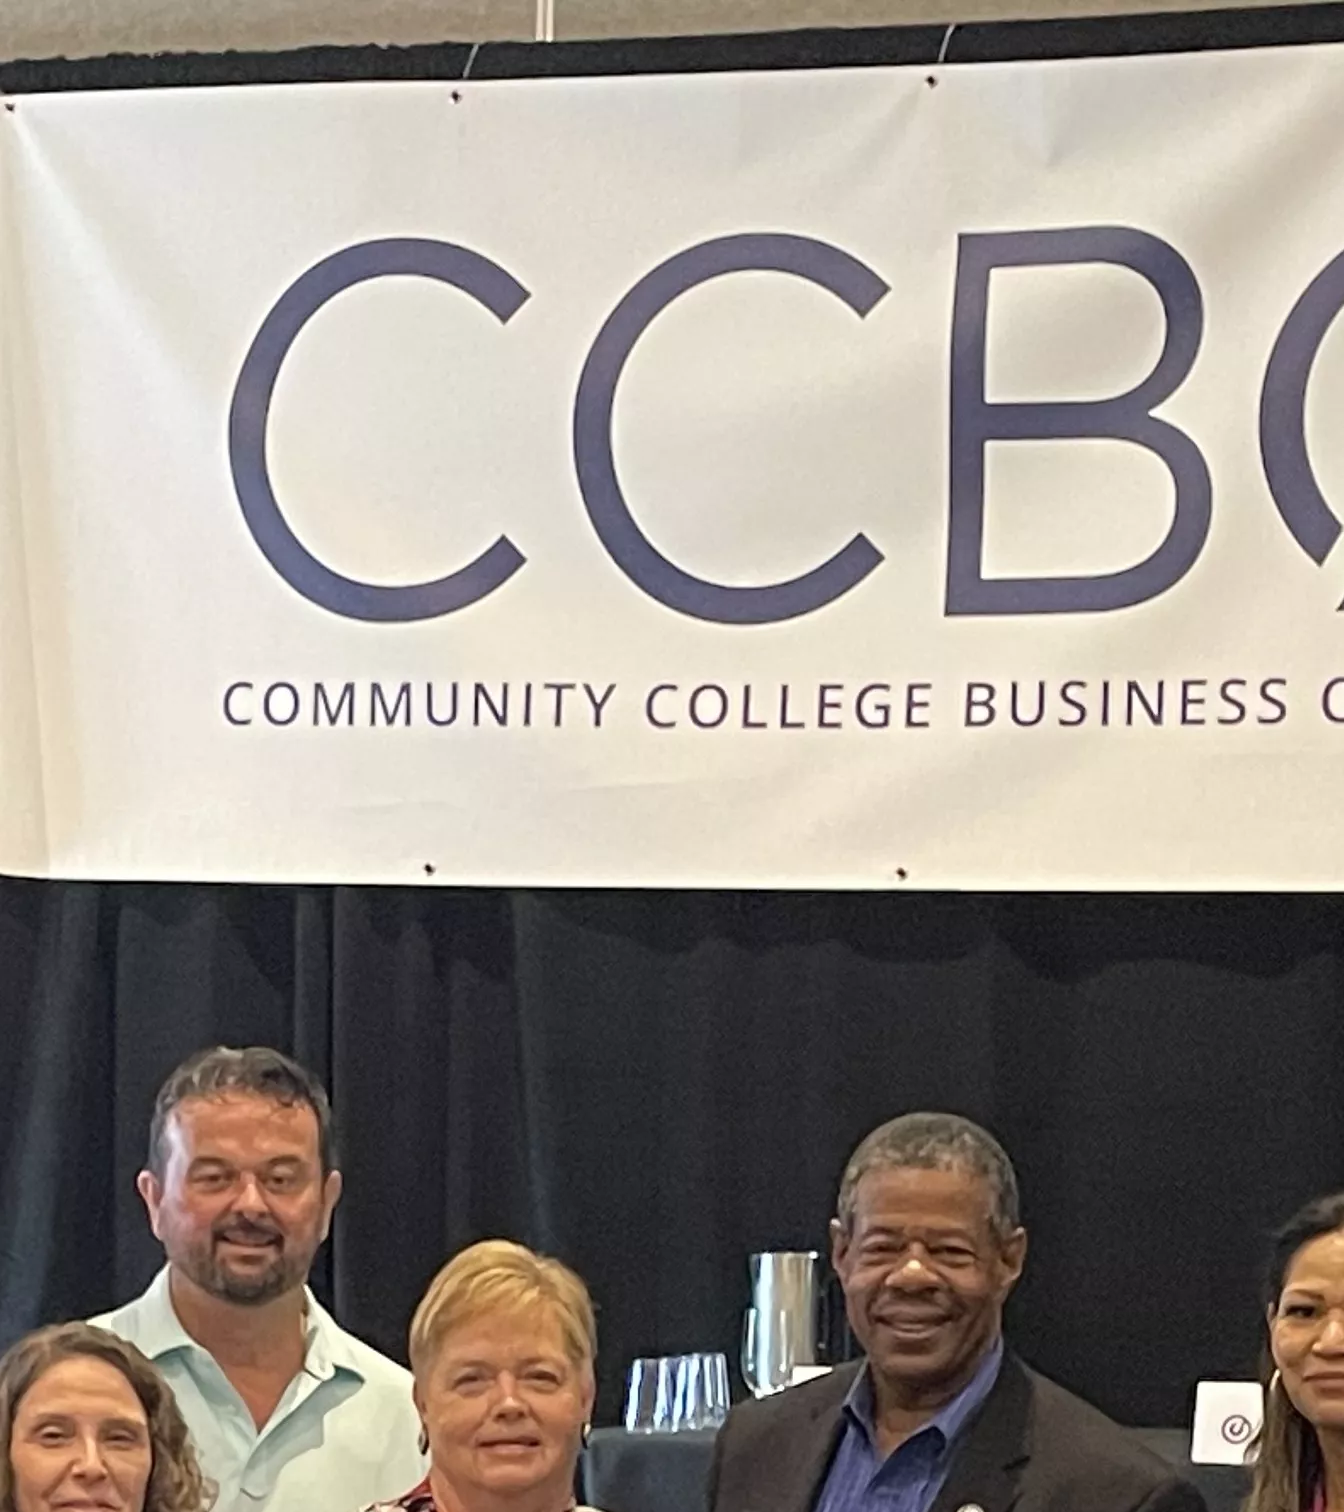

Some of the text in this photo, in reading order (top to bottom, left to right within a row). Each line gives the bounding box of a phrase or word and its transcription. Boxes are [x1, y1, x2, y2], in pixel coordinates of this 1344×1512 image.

[223, 680, 618, 728] COMMUNITY
[645, 683, 933, 730] COLLEGE
[963, 677, 1289, 728] BUSINESS
